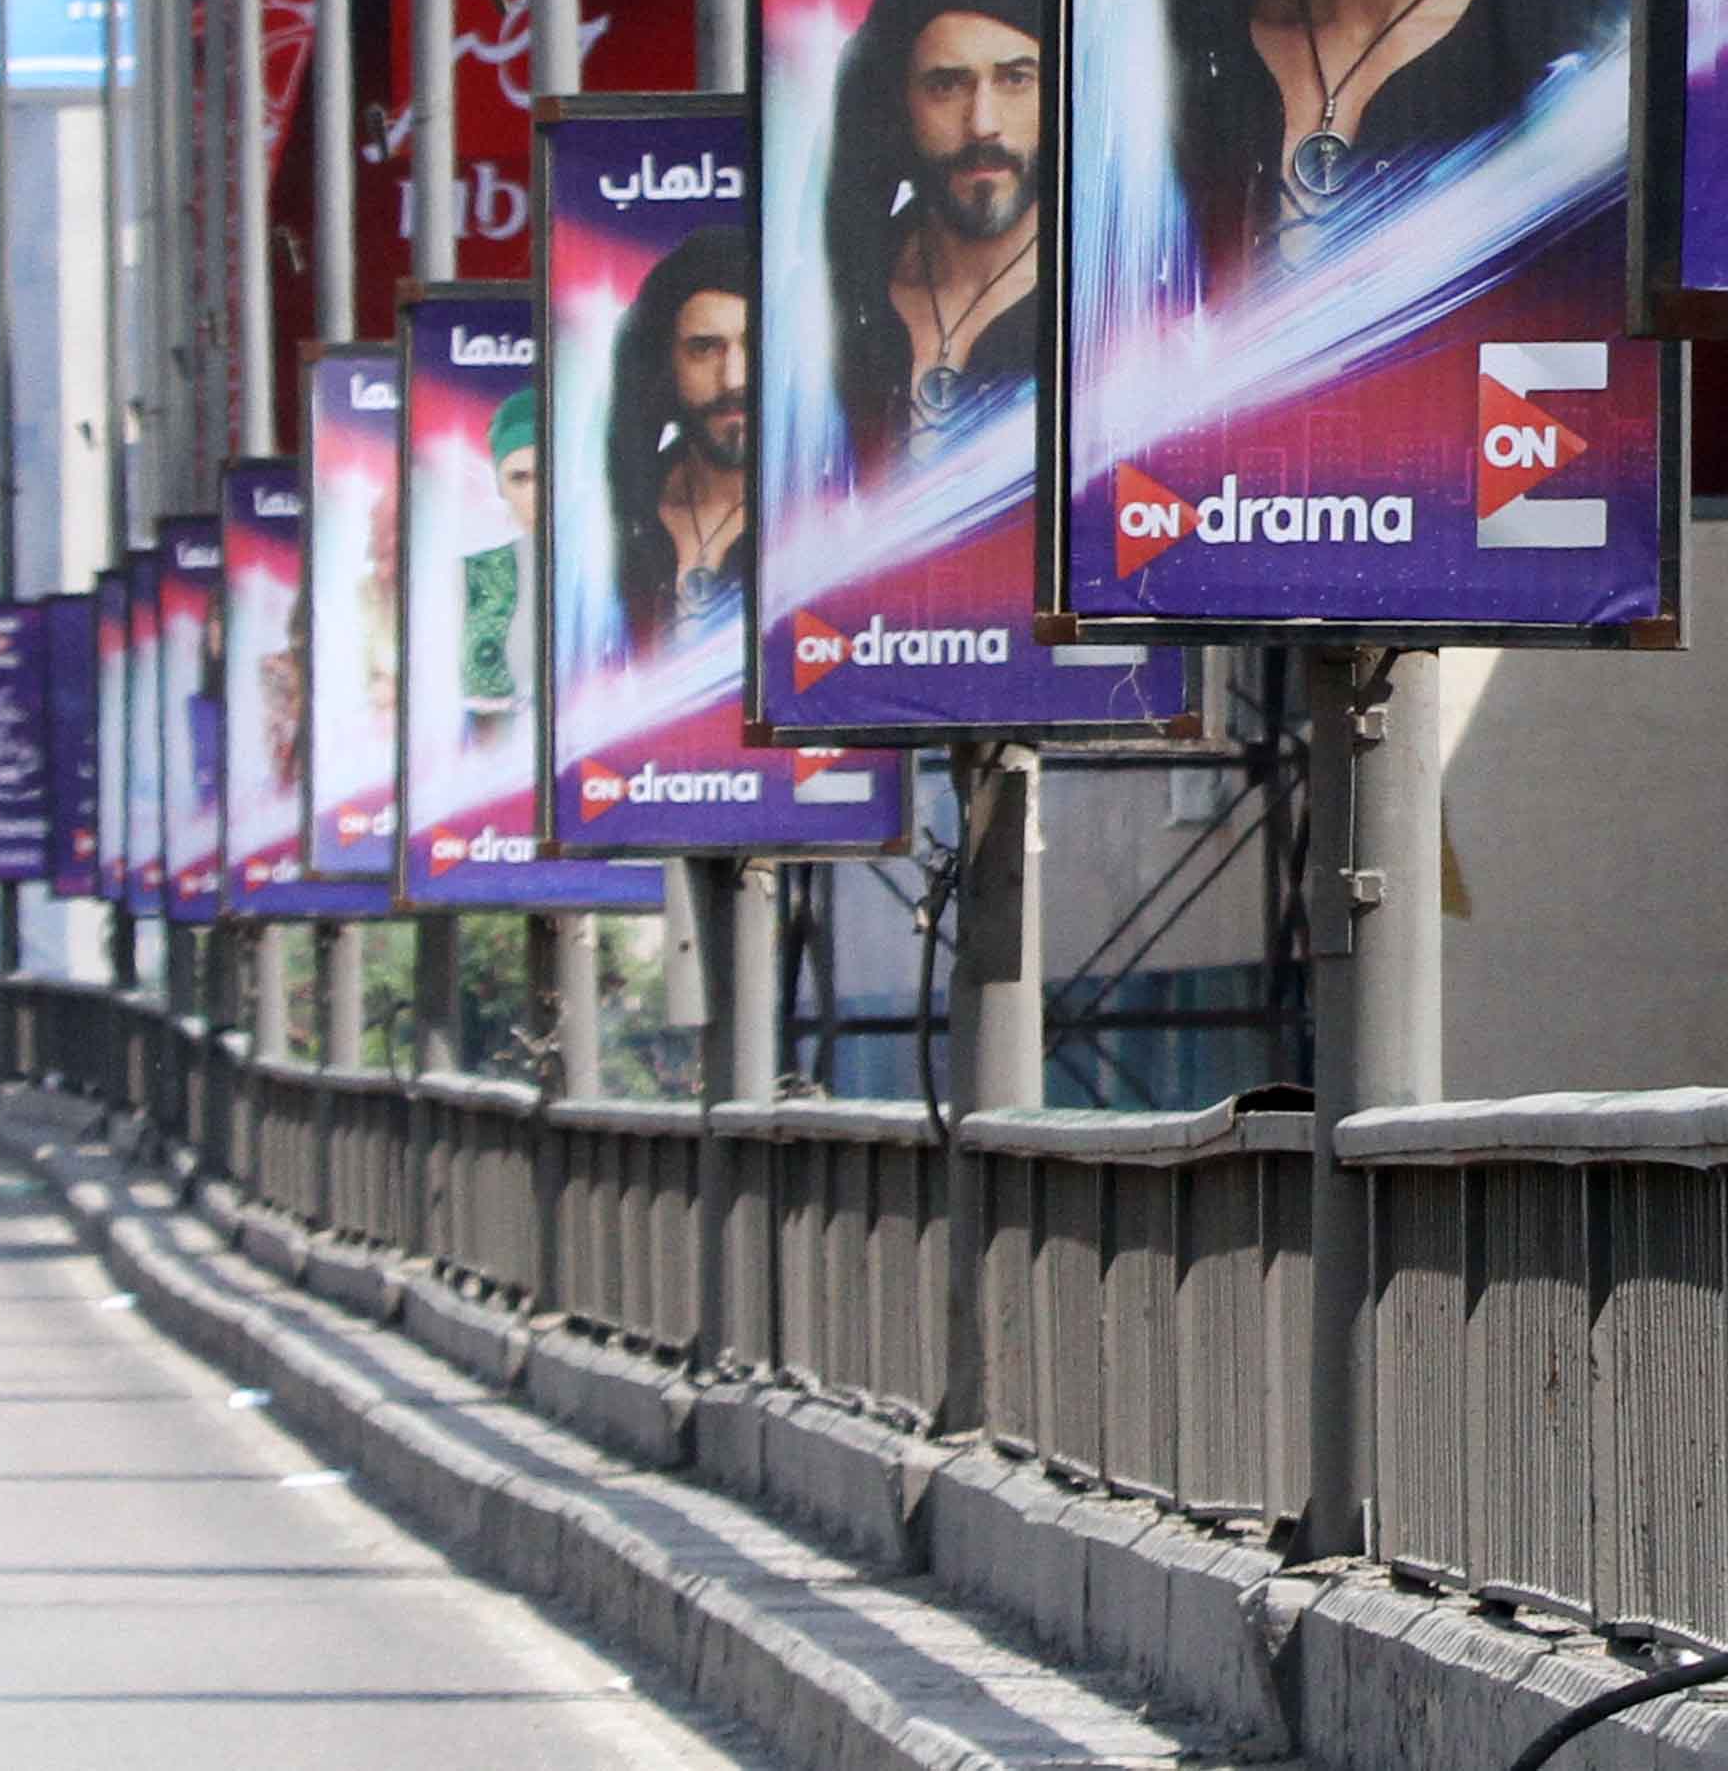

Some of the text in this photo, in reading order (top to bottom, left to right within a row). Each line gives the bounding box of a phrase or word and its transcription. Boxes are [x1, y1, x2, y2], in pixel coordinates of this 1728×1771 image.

[598, 152, 744, 210] دلهاب
[1483, 424, 1558, 469] ON
[1119, 474, 1413, 544] ON drama
[796, 615, 1009, 667] ON drama
[627, 761, 762, 803] drama
